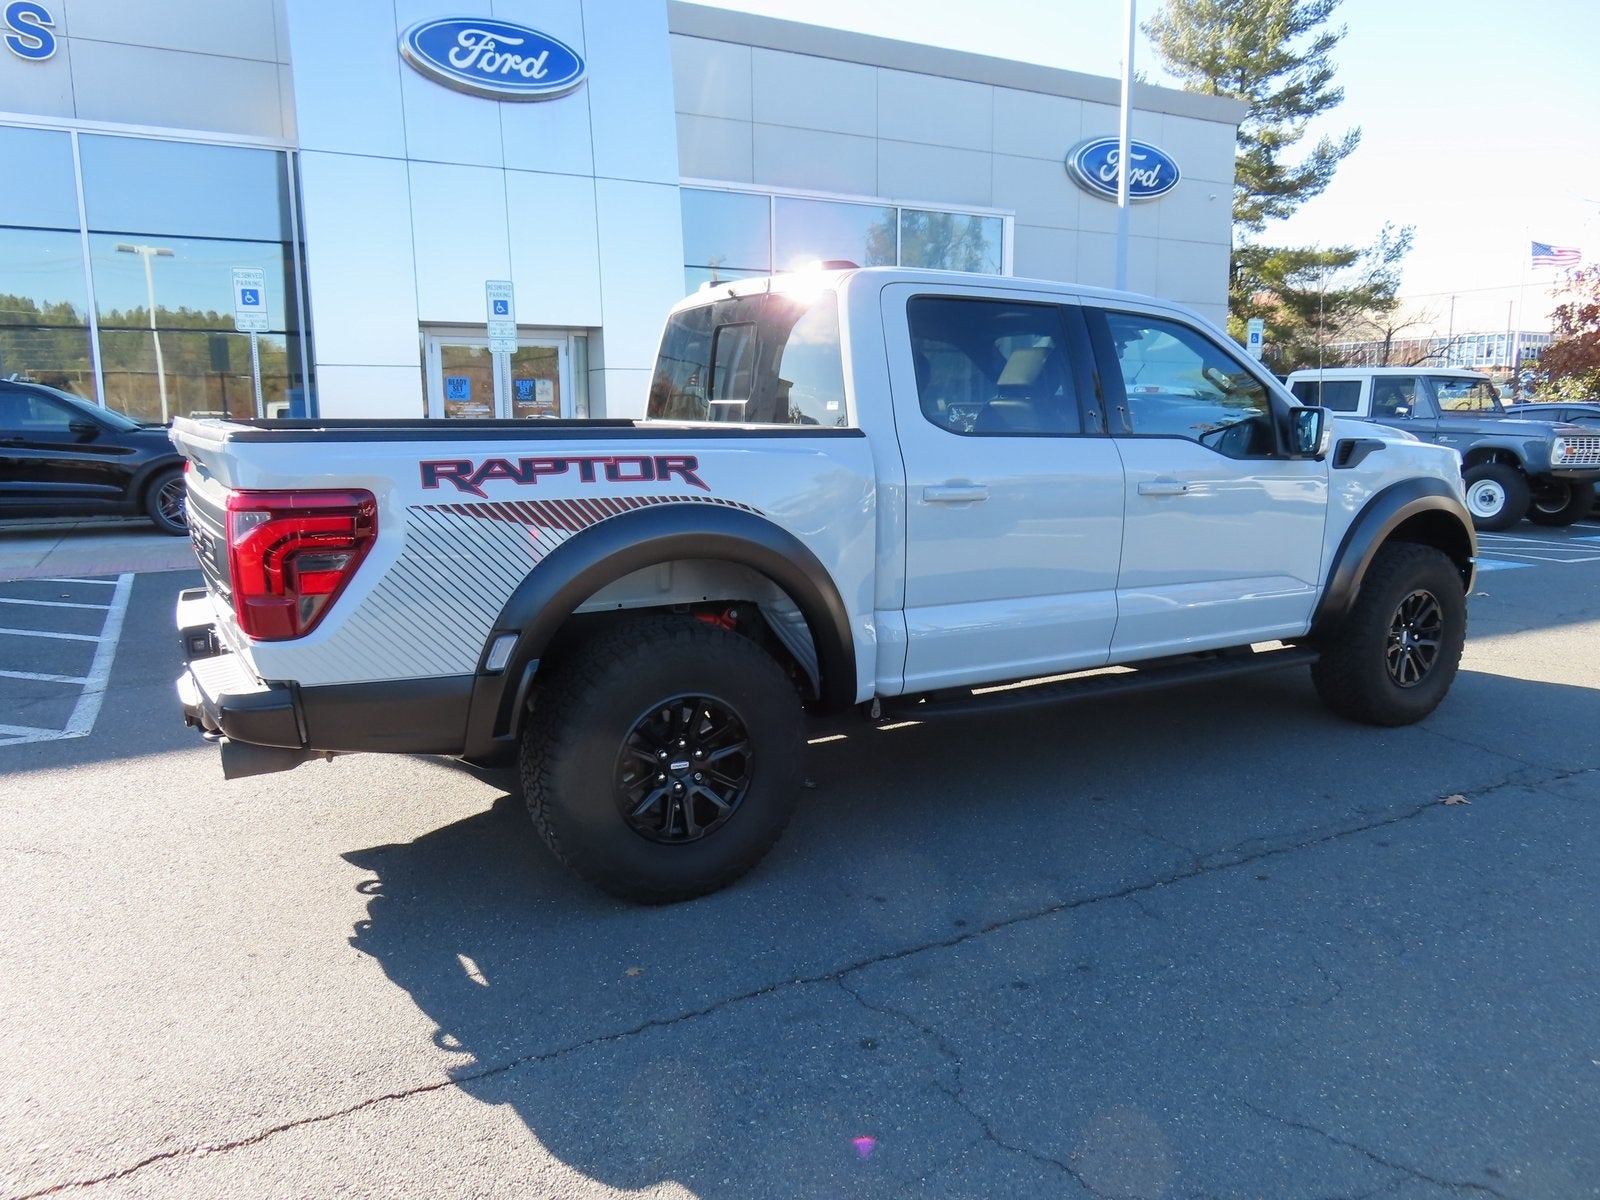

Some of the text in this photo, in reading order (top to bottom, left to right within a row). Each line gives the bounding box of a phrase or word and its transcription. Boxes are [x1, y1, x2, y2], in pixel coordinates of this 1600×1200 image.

[3, 0, 57, 60] S
[448, 28, 549, 79] Ford
[1099, 149, 1161, 188] Frd
[233, 272, 263, 280] RESERVED
[236, 280, 263, 288] PARKING
[448, 378, 467, 386] READY
[452, 385, 463, 393] SET
[419, 455, 711, 499] RAPTOR
